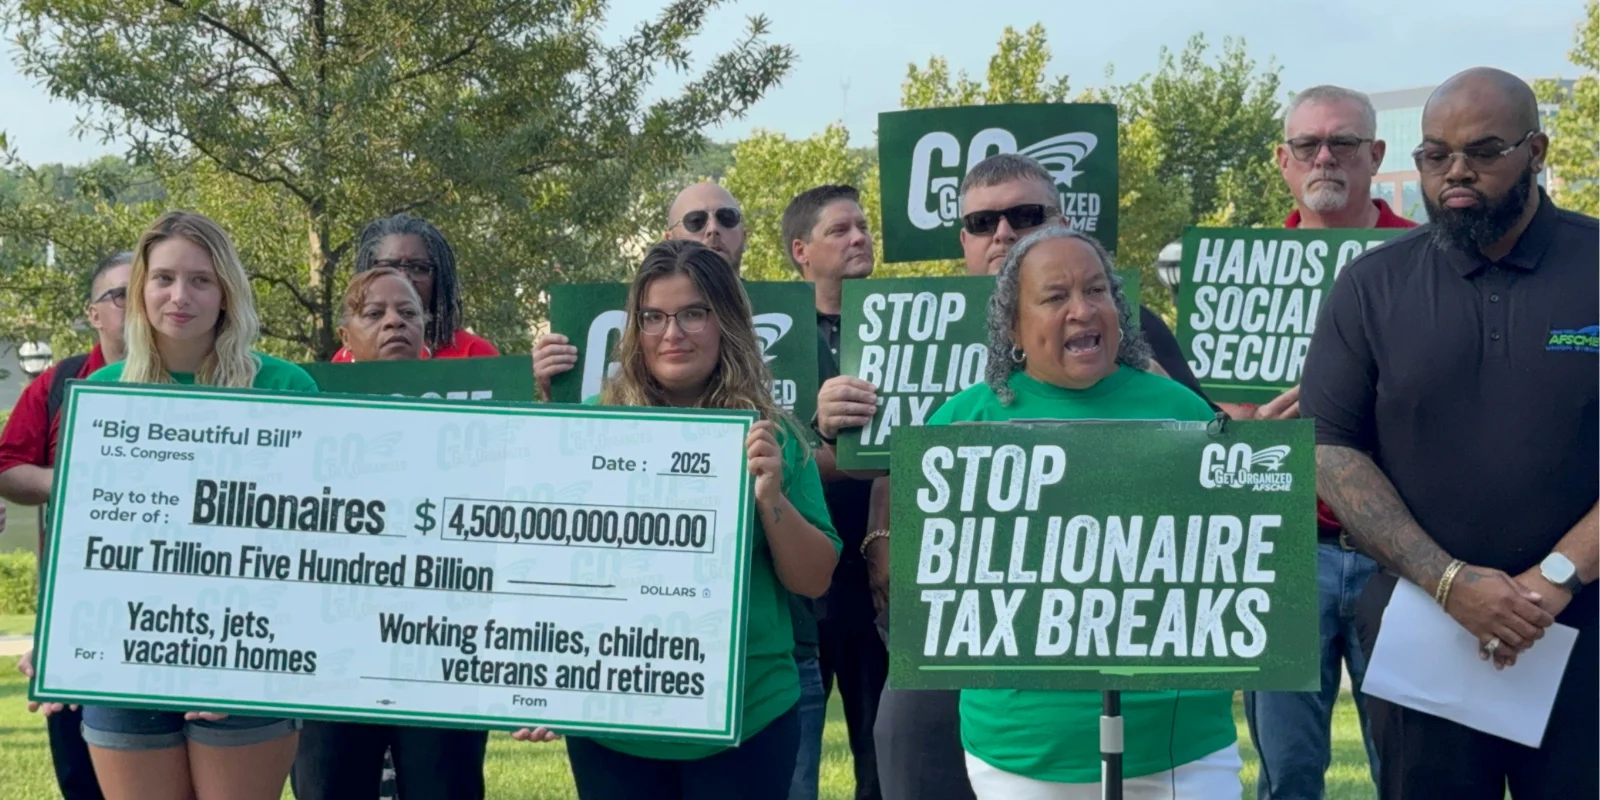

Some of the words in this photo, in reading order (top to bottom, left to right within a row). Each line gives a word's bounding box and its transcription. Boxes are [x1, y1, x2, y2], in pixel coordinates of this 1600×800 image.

[1193, 238, 1328, 286] HANDS
[858, 291, 966, 343] STOP
[859, 343, 988, 393] BILLIO
[1188, 333, 1312, 382] SECUR
[100, 445, 126, 458] U.S.
[130, 447, 195, 462] Congress
[147, 422, 250, 446] Beautiful
[591, 455, 636, 473] Date
[670, 451, 711, 475] 2025
[917, 444, 1066, 513] STOP
[1199, 442, 1253, 488] GO
[1214, 467, 1235, 484] GET
[1238, 468, 1292, 485] ORGANIZED
[92, 488, 124, 506] Pay
[128, 489, 146, 504] to
[151, 490, 180, 506] the
[192, 478, 387, 535] Billionaires
[1252, 484, 1291, 492] AFSCME
[89, 508, 137, 523] order
[141, 509, 161, 523] of
[448, 503, 707, 548] 4,500,000,000,000.00
[85, 536, 144, 571] Four
[150, 539, 232, 577] Trillion
[239, 544, 291, 580] Five
[297, 548, 406, 586] Hundred
[413, 554, 494, 592] Billion
[640, 585, 697, 598] DOLLARS
[917, 514, 1282, 584] BILLIONAIRE
[127, 601, 216, 640] Yachts,
[220, 607, 275, 644] jets,
[379, 612, 479, 655] Working
[484, 619, 591, 657] families,
[598, 625, 706, 664] children,
[920, 588, 1027, 657] TAX
[1034, 587, 1271, 658] BREAKS
[74, 647, 96, 660] For
[122, 636, 228, 669] vacation
[234, 640, 317, 674] homes
[441, 655, 548, 688] veterans
[555, 659, 601, 691] and
[606, 662, 706, 697] retirees
[512, 694, 548, 708] From
